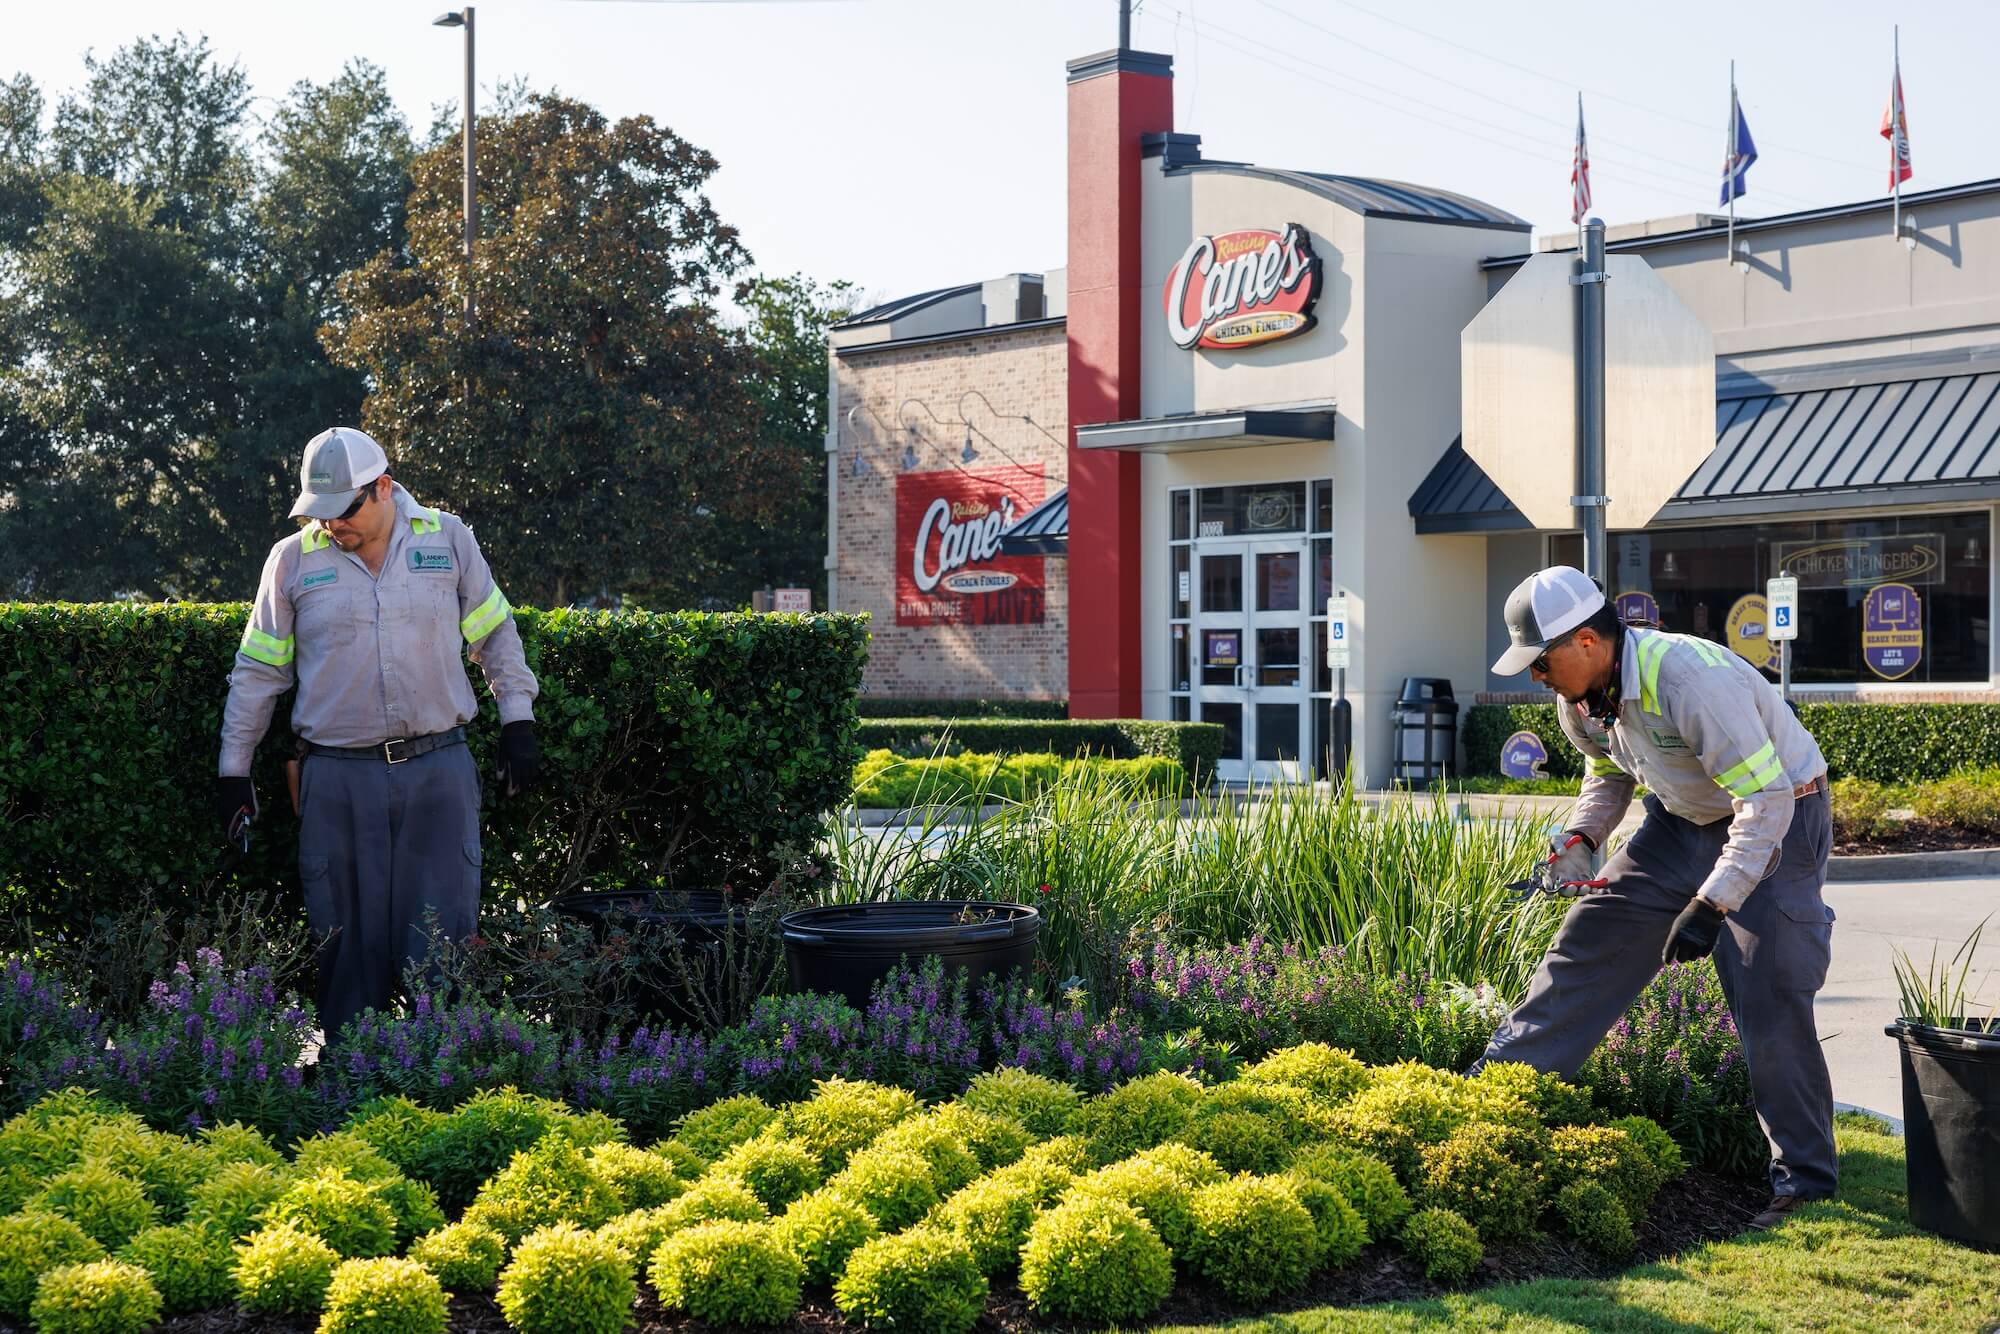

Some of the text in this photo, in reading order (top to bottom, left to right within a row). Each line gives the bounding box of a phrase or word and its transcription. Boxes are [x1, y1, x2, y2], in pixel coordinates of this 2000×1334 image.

[1217, 234, 1266, 260] Raising
[1168, 222, 1310, 347] Cane's
[1215, 323, 1253, 339] CHICKEN
[952, 501, 989, 519] Raising
[1797, 551, 1919, 575] CHICKEN FINGERS
[931, 601, 961, 617] ROUGE
